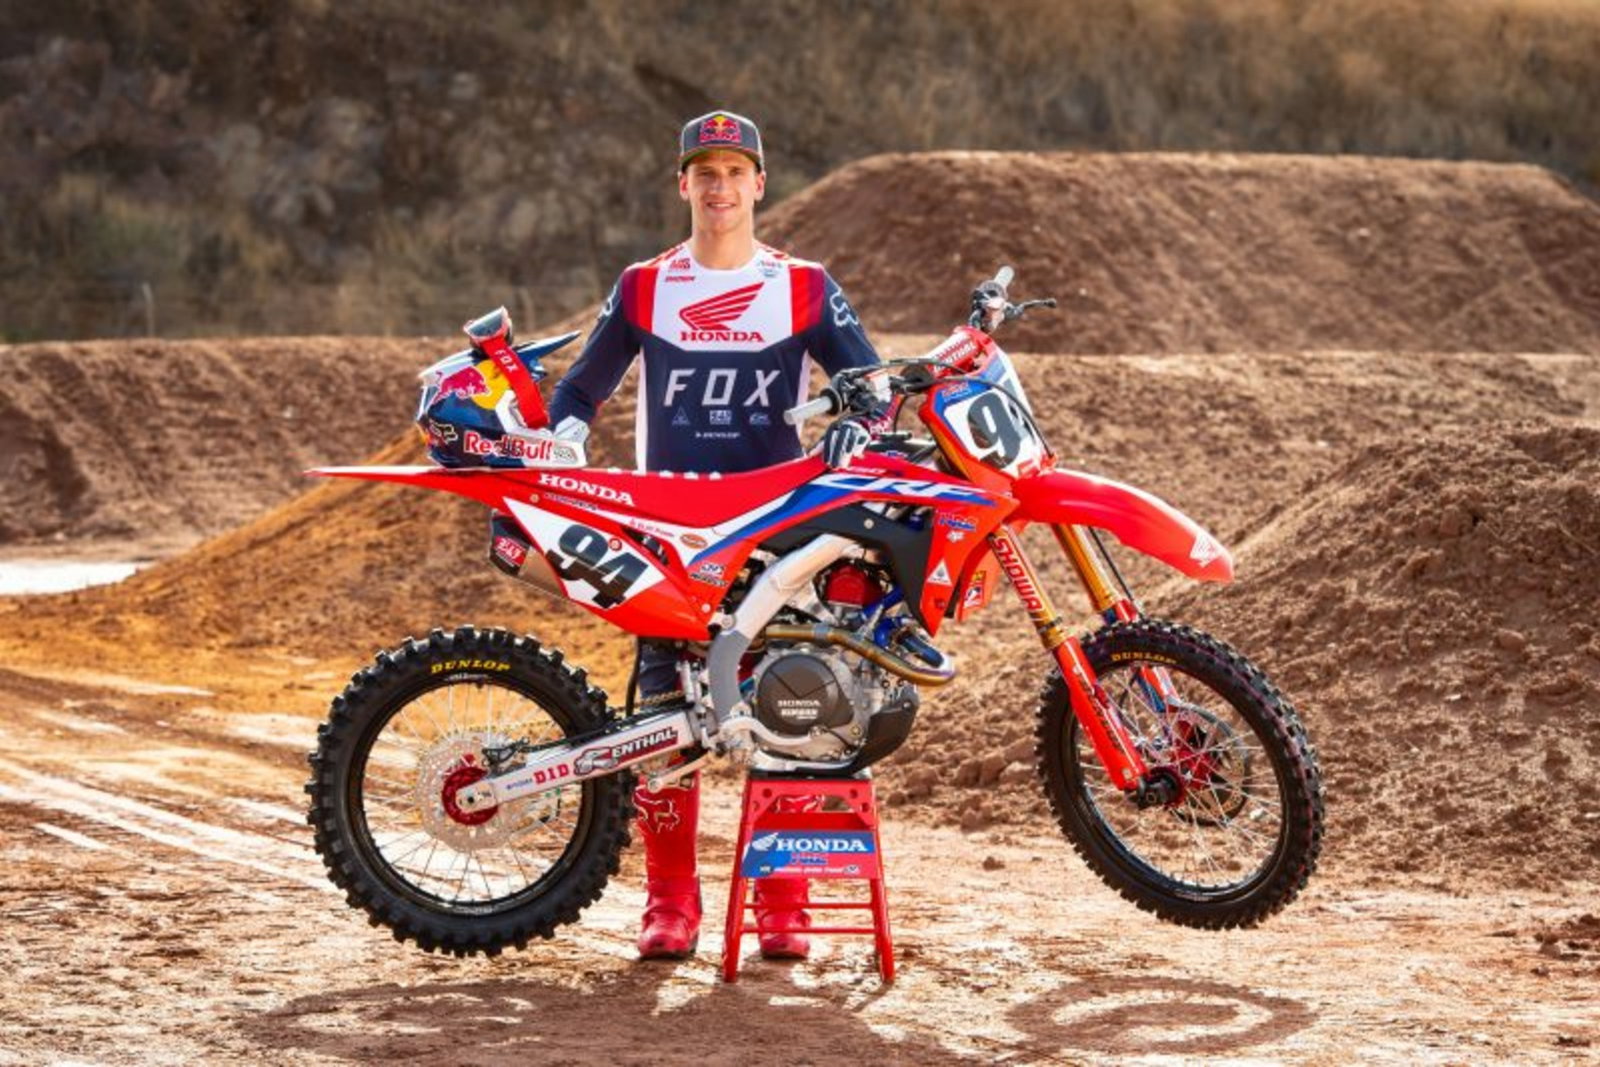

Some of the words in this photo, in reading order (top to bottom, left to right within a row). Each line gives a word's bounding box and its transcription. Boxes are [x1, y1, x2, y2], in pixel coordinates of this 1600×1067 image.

[680, 331, 765, 342] HONDA
[495, 349, 519, 372] FOX
[663, 368, 781, 408] FOX
[464, 431, 510, 456] Red
[511, 437, 553, 461] Bull
[538, 473, 635, 506] HONDA
[546, 524, 649, 609] 94
[992, 536, 1044, 612] SHOWA
[430, 659, 511, 674] DUNLOP
[533, 763, 569, 784] DID
[775, 838, 868, 852] HONDA
